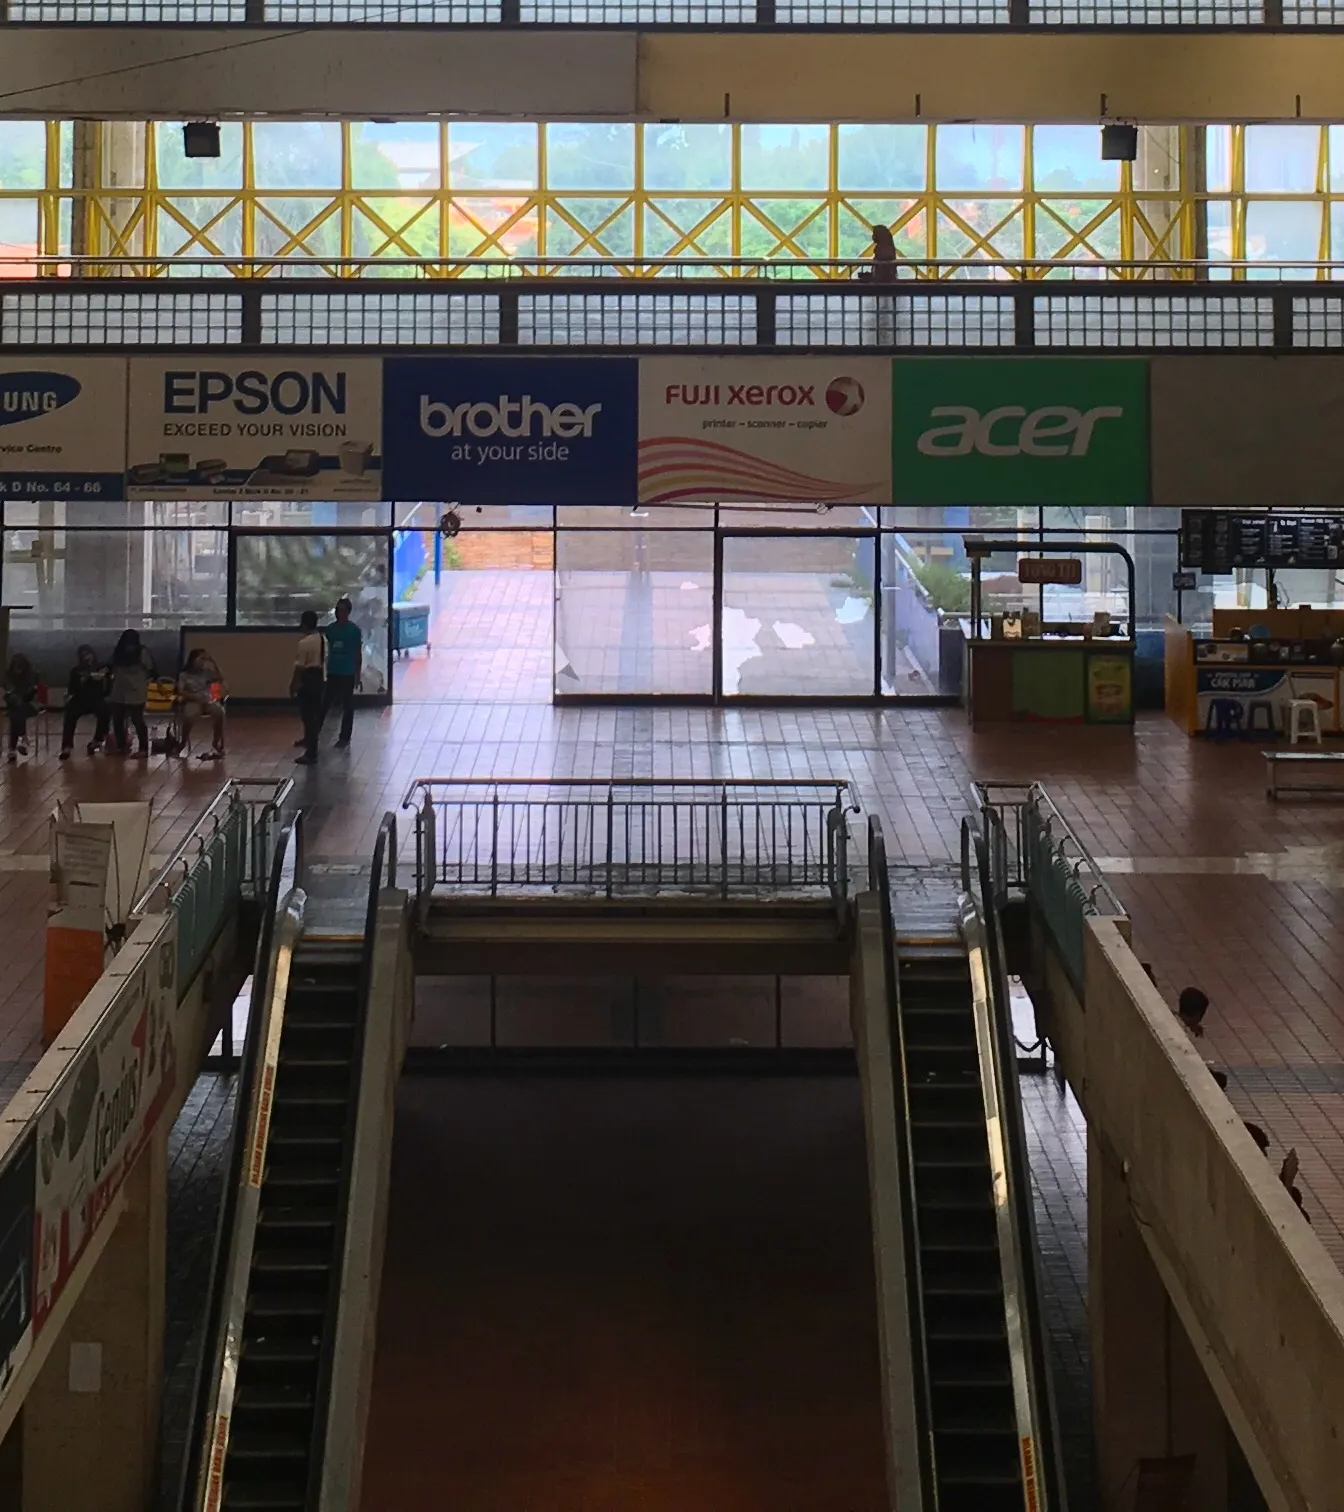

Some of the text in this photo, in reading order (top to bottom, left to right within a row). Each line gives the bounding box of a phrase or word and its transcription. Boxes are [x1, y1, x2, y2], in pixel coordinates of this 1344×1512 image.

[164, 370, 346, 415] EPSON
[666, 384, 719, 405] FUJI
[419, 394, 602, 437] brother
[702, 420, 737, 430] printer
[747, 420, 786, 429] scanner
[797, 419, 828, 430] copier
[163, 423, 347, 437] EXCEED YOUR VISION
[917, 405, 1123, 457] acer
[27, 443, 62, 453] Centre
[451, 441, 570, 466] at your side
[12, 481, 22, 493] D
[26, 481, 50, 493] No.
